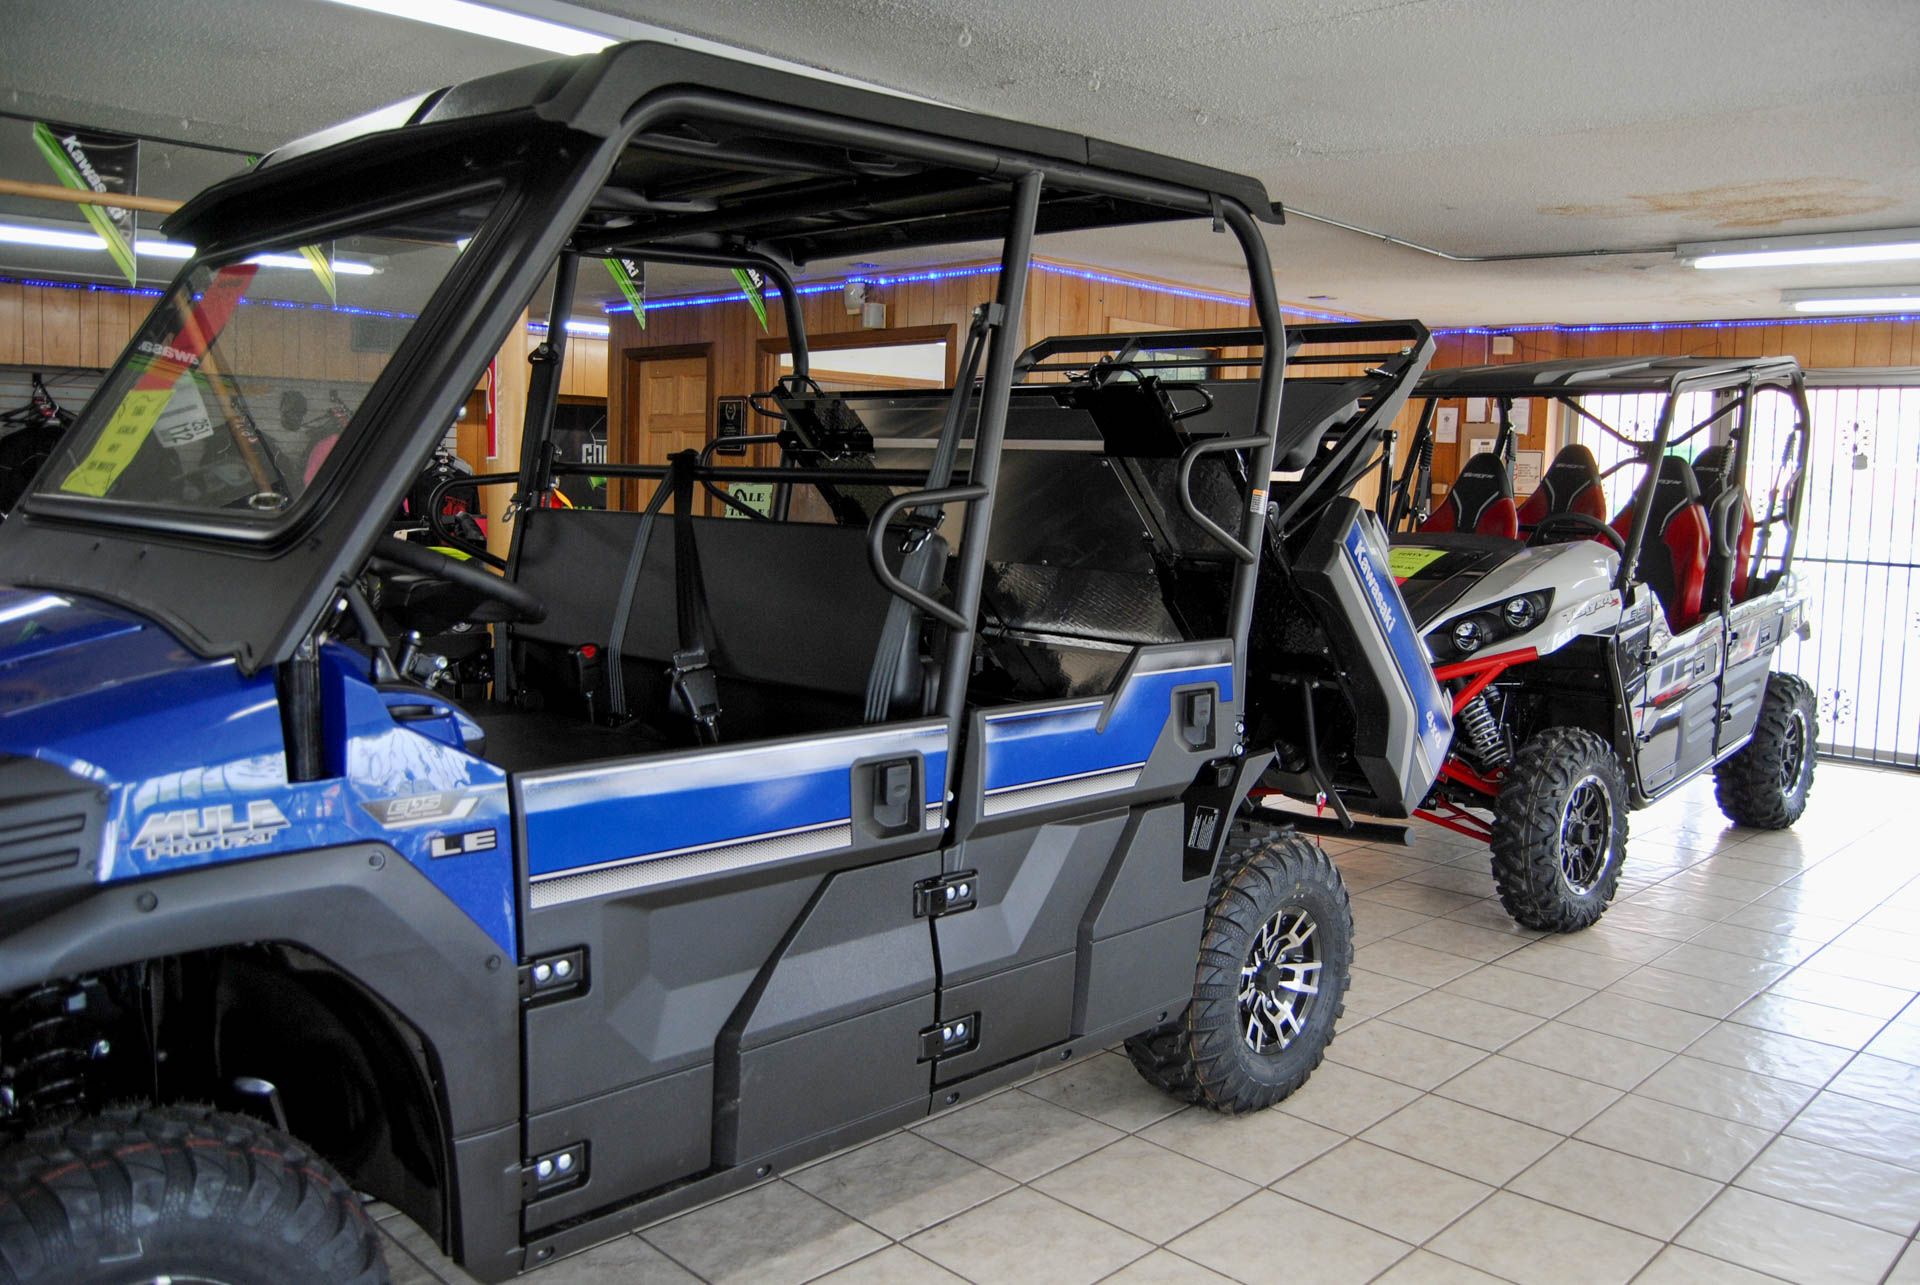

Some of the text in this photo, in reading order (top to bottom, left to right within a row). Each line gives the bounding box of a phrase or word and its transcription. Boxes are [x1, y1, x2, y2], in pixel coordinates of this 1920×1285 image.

[1354, 539, 1397, 634] Kawasaki
[131, 799, 291, 850] MULE
[430, 829, 497, 859] LE
